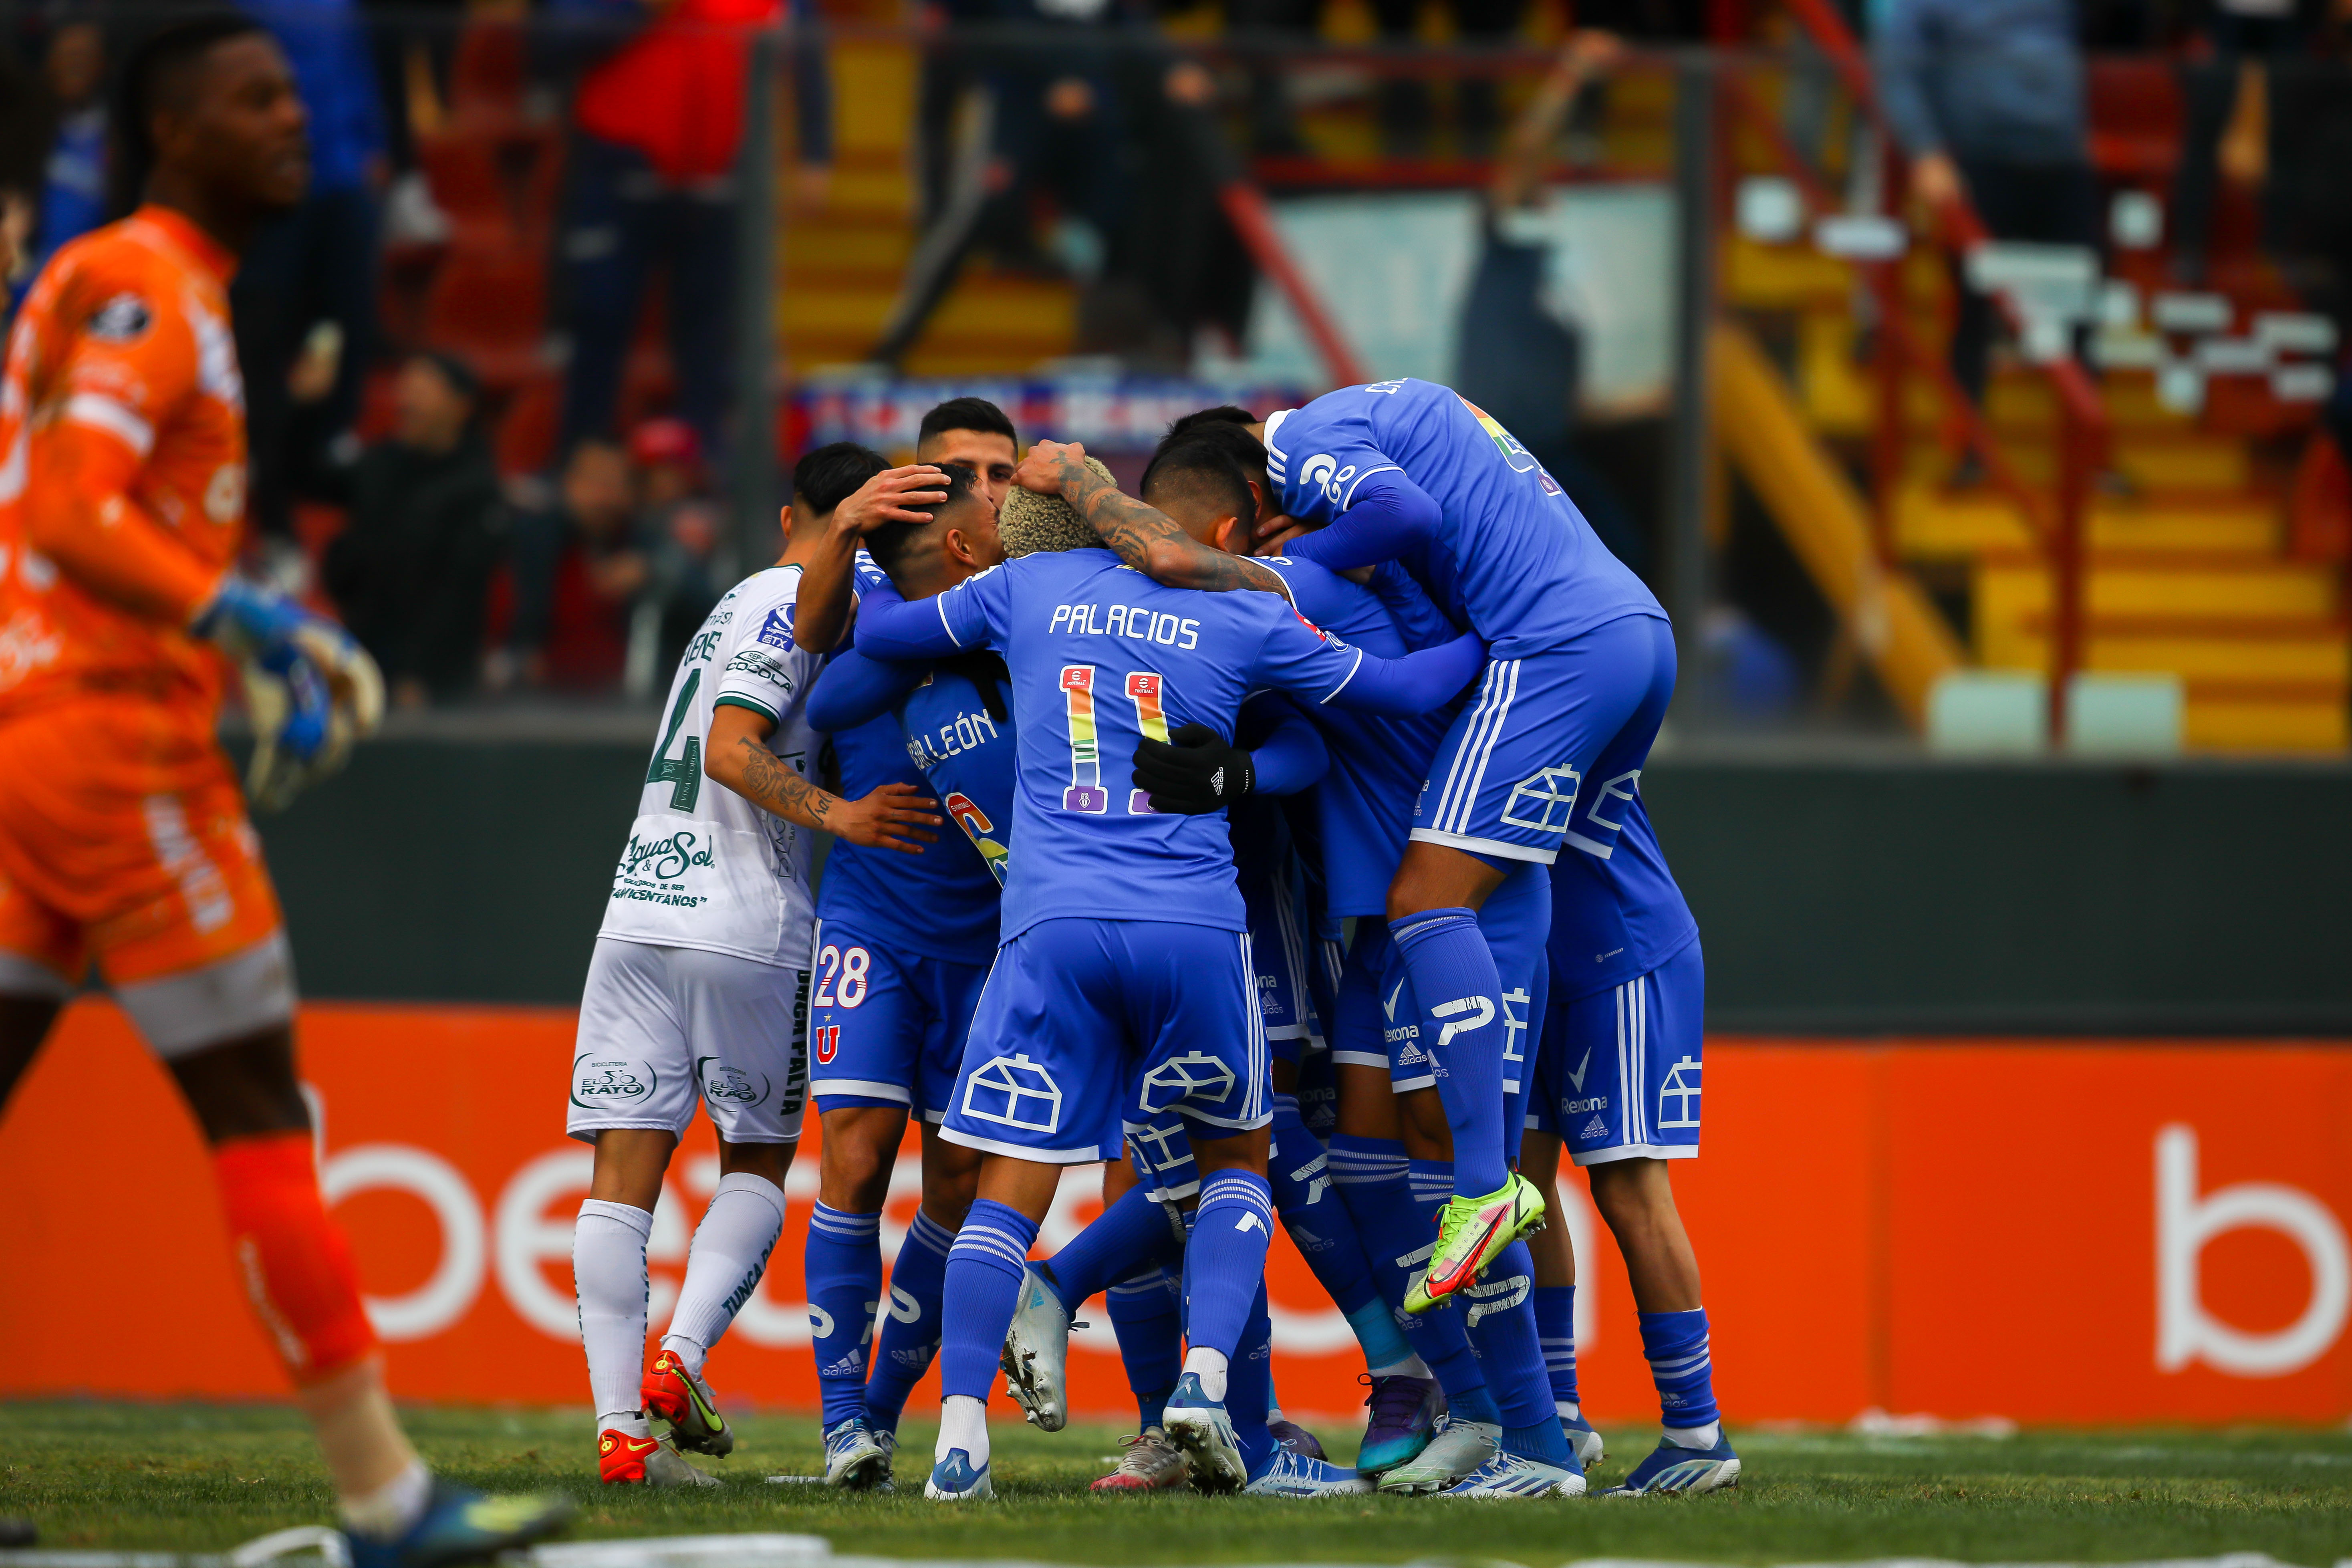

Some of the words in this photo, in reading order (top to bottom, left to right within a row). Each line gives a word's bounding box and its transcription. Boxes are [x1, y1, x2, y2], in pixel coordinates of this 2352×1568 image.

[766, 626, 793, 639] Segunda
[1049, 604, 1201, 650] PALACIOS
[726, 661, 792, 694] COCOLA
[748, 652, 783, 670] REPUESTOS
[646, 668, 701, 814] 4
[924, 708, 998, 760] LEÓN
[656, 832, 714, 880] Sol
[814, 944, 871, 1009] 28
[816, 1025, 840, 1065] U
[1398, 1054, 1427, 1066] adidas
[580, 1084, 644, 1096] RAYO
[780, 1042, 807, 1116] PALTA
[1562, 1096, 1607, 1115] Rexona
[1580, 1128, 1608, 1139] adidas
[721, 1262, 763, 1318] TUNCA
[822, 1364, 865, 1376] adidas
